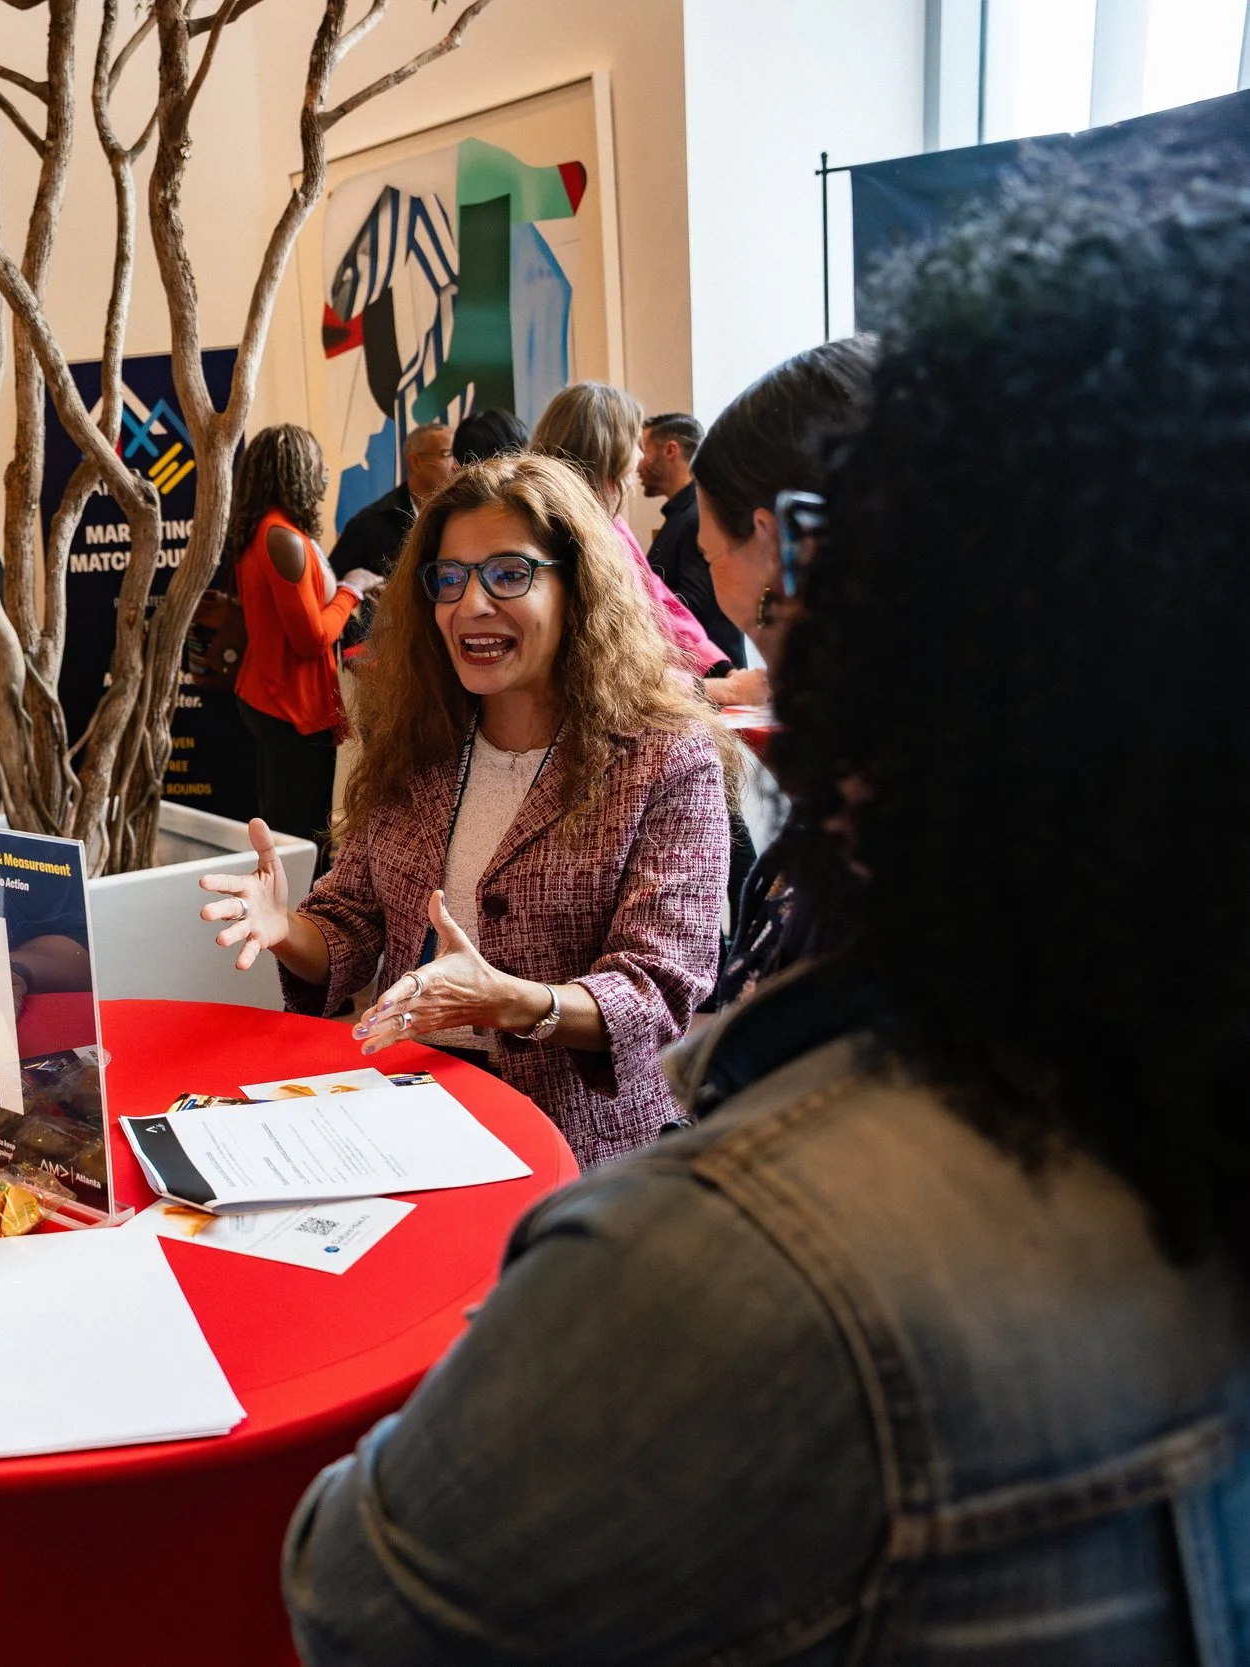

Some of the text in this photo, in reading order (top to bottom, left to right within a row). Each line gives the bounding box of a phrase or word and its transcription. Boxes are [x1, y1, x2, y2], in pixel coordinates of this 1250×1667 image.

[85, 519, 194, 545] MARTIN
[4, 853, 72, 877] Measurement
[5, 877, 30, 892] Action
[75, 1172, 102, 1190] Atlanta
